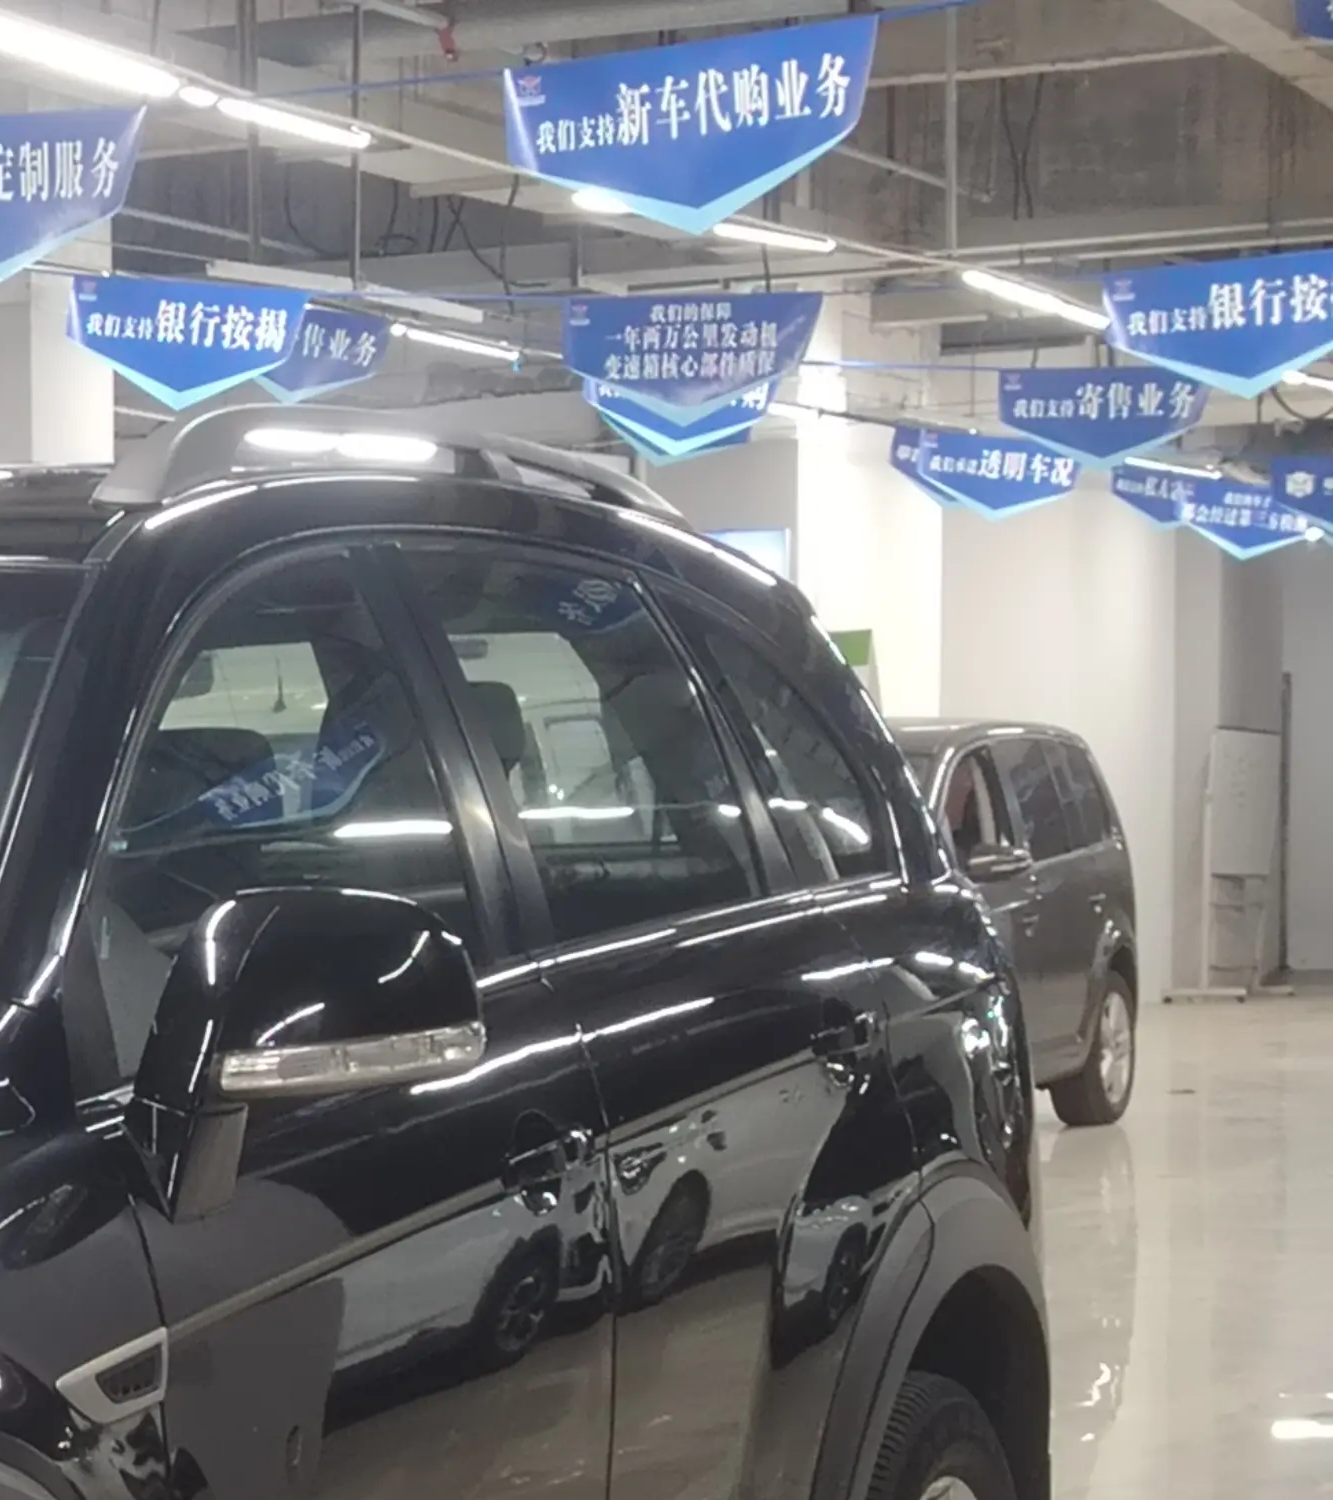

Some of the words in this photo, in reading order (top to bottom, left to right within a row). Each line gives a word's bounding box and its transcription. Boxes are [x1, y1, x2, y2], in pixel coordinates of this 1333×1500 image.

[536, 52, 851, 154] 我们支持新车代购业务
[86, 299, 288, 353] 我们支持银行按揭
[650, 302, 732, 323] 我们的保障
[1127, 273, 1333, 336] 我们支持银行按
[294, 320, 377, 368] 售业务
[605, 321, 779, 349] 一年两万公里发动机
[605, 351, 777, 381] 变速箱核心部件质保
[1012, 380, 1195, 420] 我们支持寄售业务
